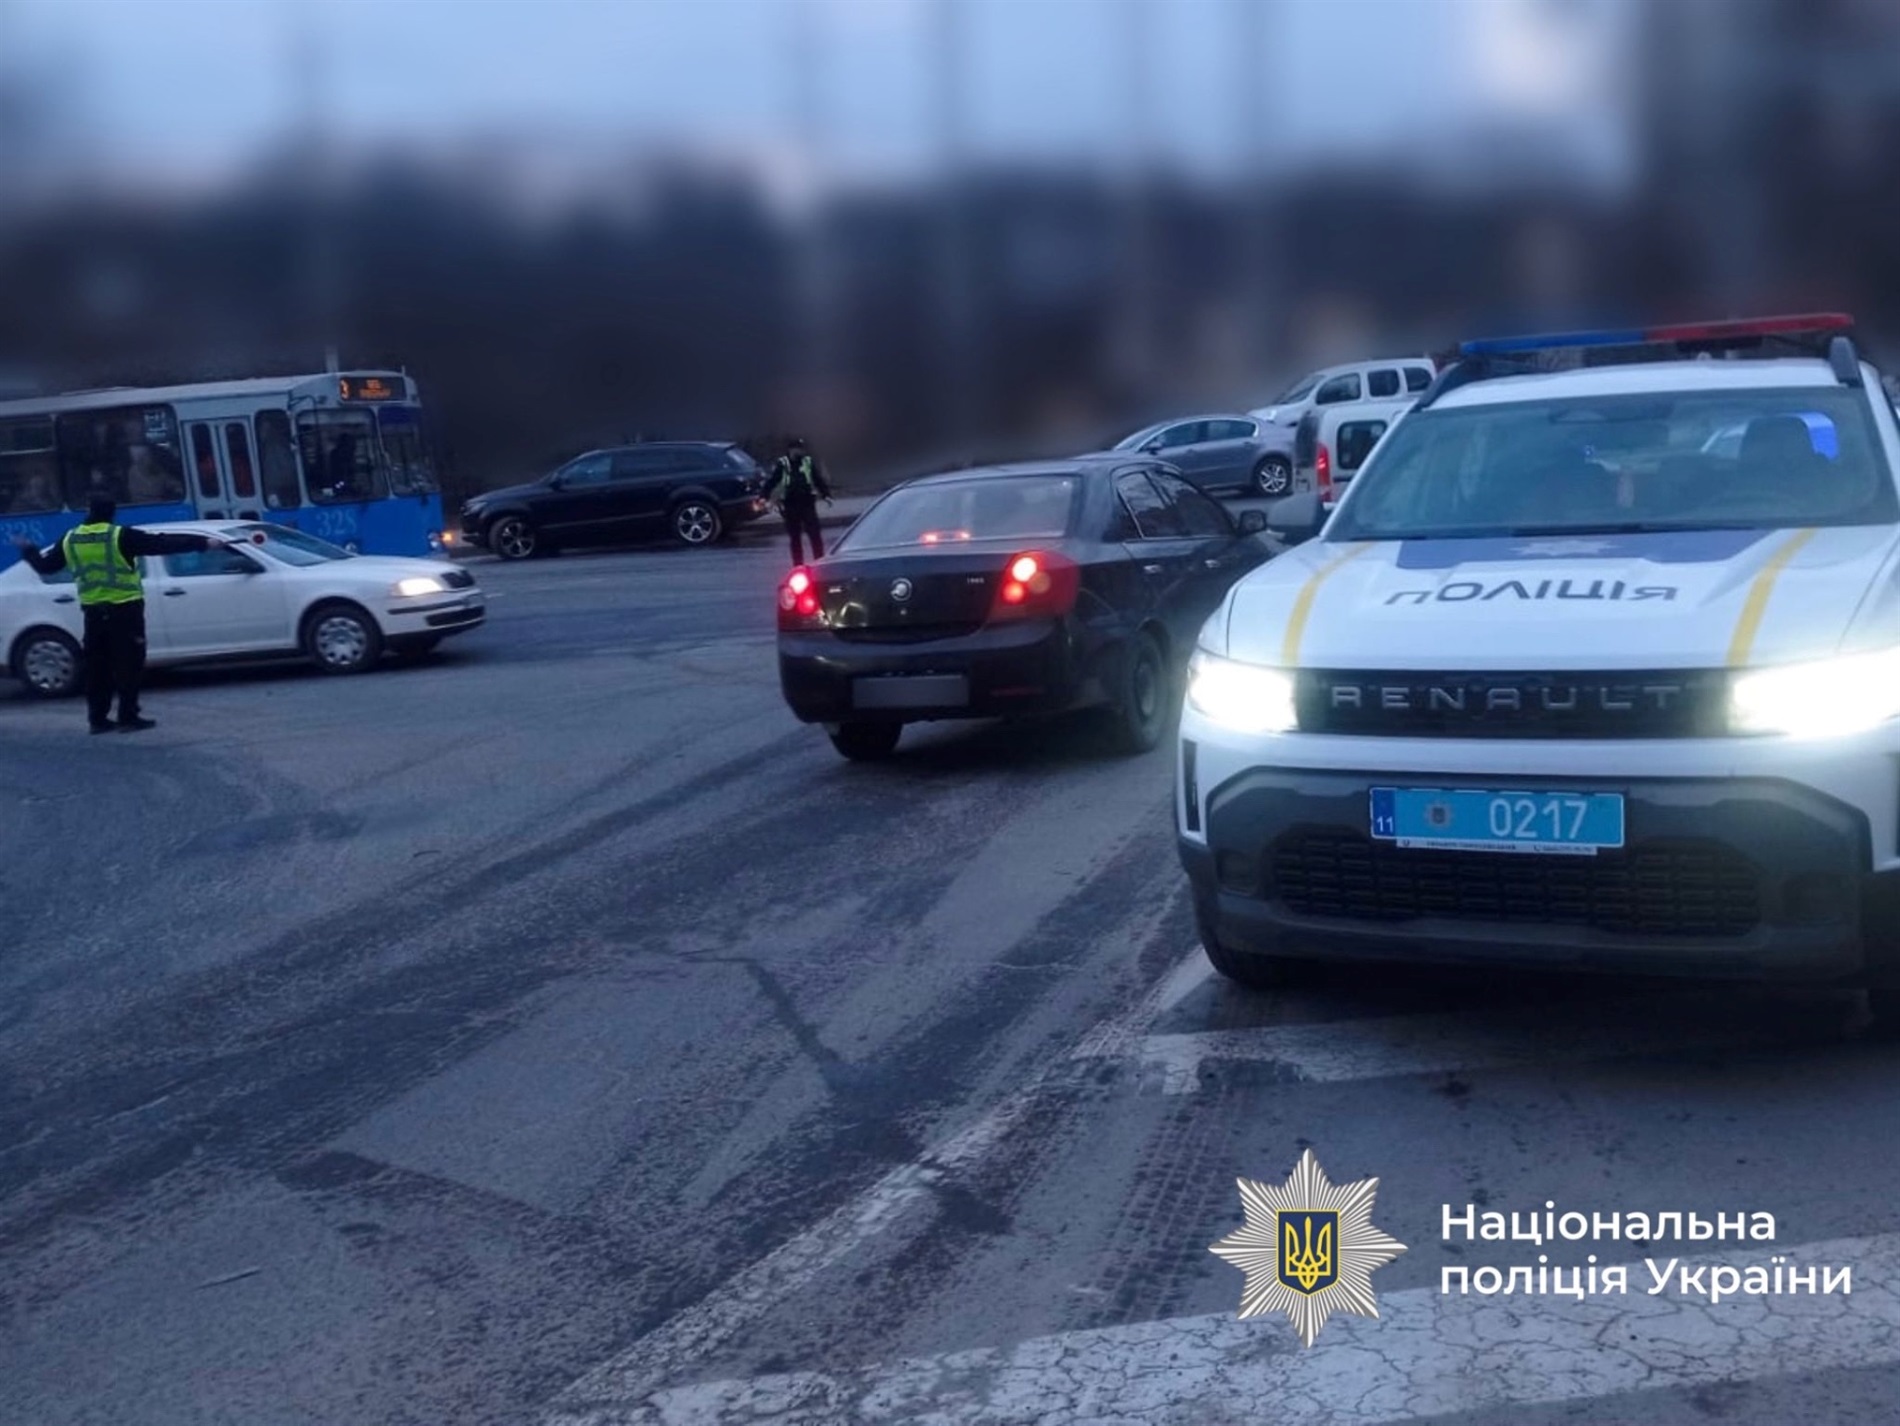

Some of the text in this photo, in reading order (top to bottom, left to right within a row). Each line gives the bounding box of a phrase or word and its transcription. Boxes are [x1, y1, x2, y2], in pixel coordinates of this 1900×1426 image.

[340, 379, 350, 400] 3
[1383, 580, 1678, 605] ПОЛІЦІЯ
[1331, 686, 1681, 710] RENAULT
[1376, 798, 1588, 839] 11 0217
